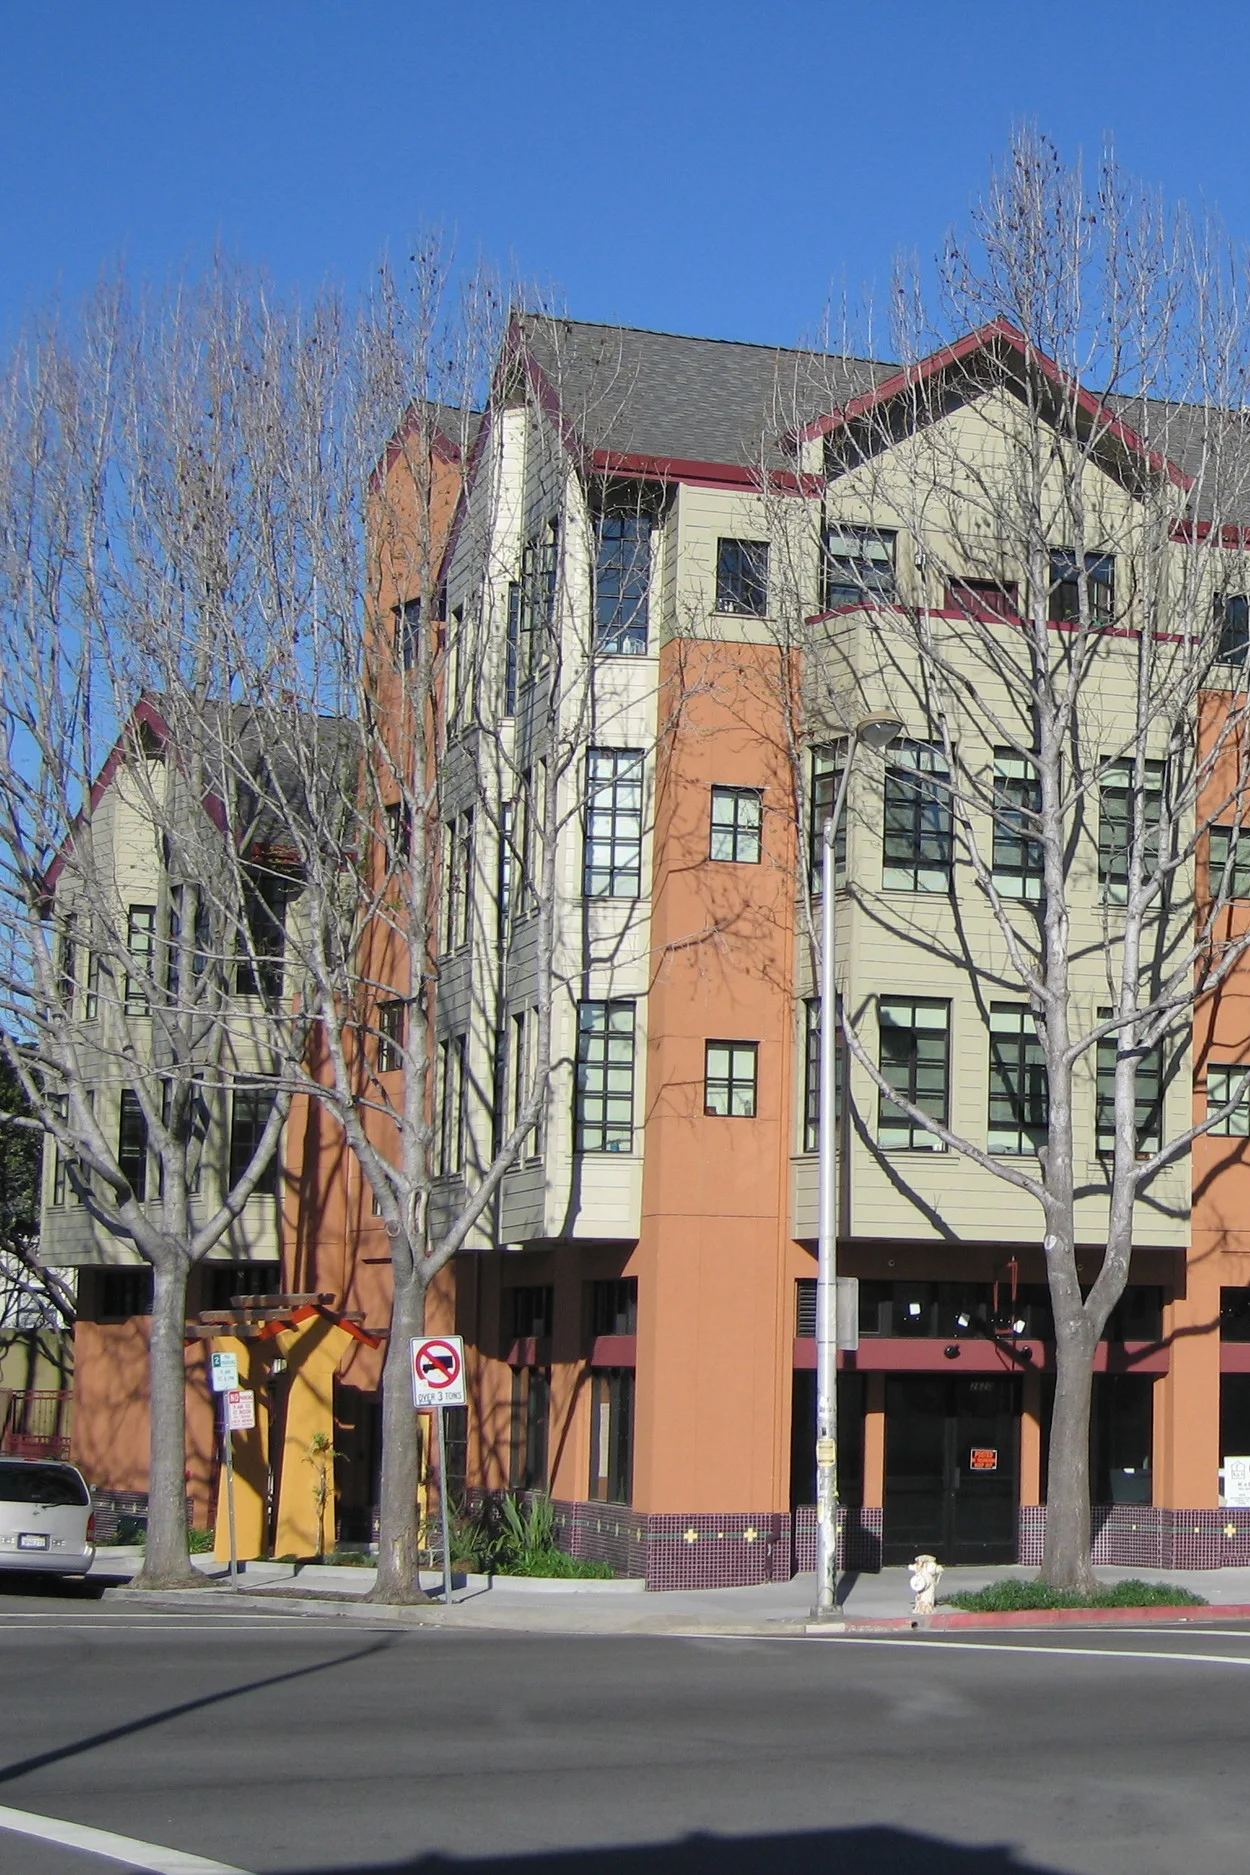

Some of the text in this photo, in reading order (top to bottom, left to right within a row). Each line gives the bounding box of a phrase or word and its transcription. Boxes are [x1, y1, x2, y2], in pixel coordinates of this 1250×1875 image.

[418, 1391, 462, 1402] OVER 3 TONS
